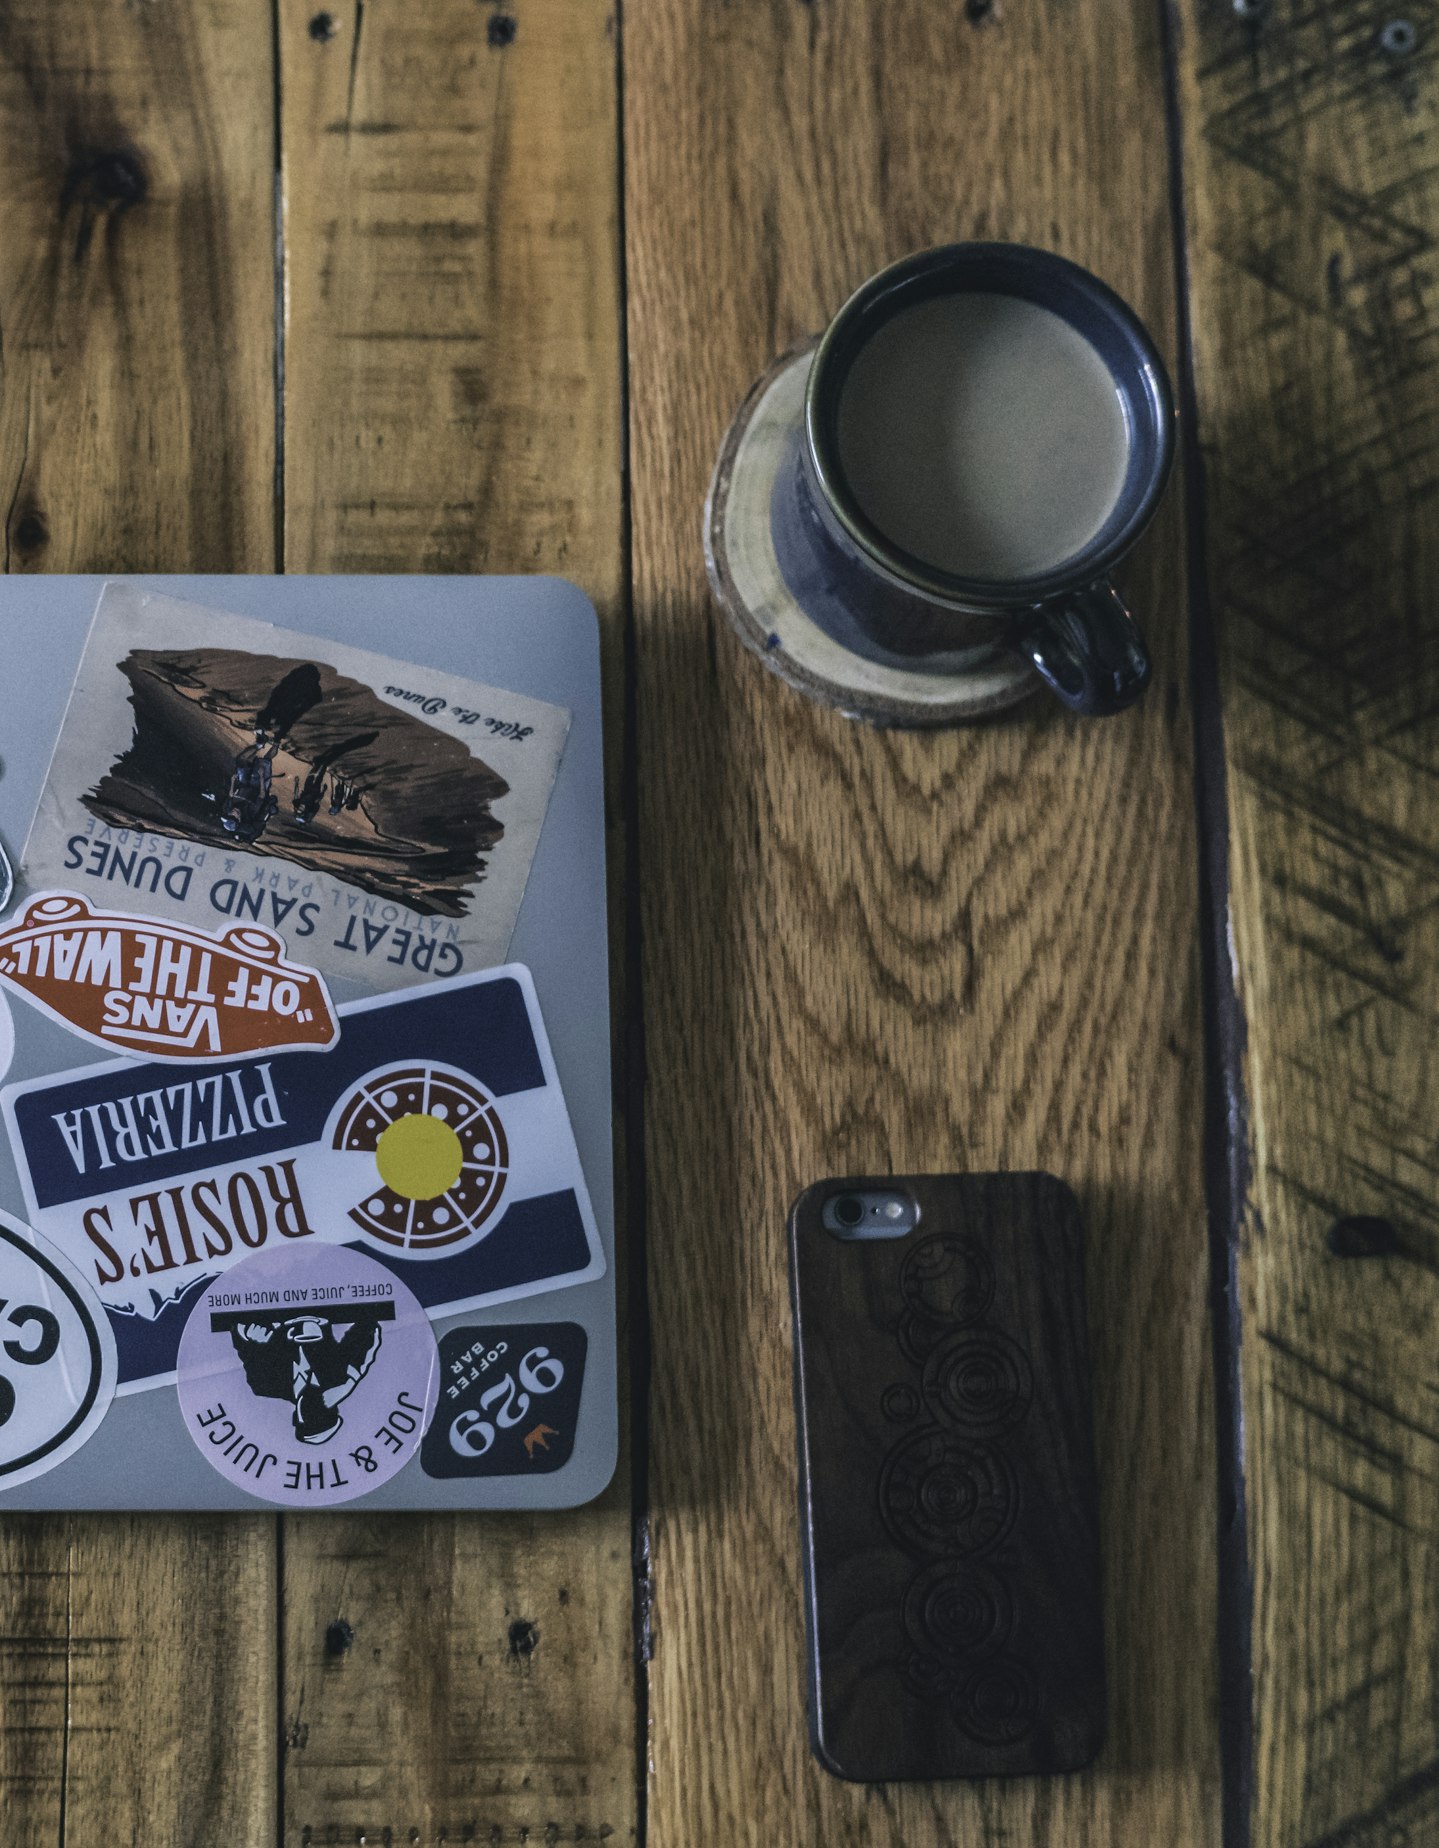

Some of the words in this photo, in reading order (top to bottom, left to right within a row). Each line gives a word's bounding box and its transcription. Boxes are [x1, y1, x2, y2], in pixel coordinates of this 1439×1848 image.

[383, 685, 447, 715] Dunes
[450, 706, 480, 725] the
[485, 718, 534, 742] Hike
[85, 818, 206, 867] PRESERVE
[223, 857, 236, 873] &
[63, 835, 194, 900] DUNES
[253, 867, 313, 898] PARK
[209, 878, 320, 937] SAND
[331, 890, 459, 941] NATIONAL
[129, 934, 215, 1001] THE
[333, 914, 464, 978] GREAT
[224, 967, 313, 1023] "OFF
[101, 990, 221, 1052] VANS
[51, 1062, 287, 1174] PIZZERIA
[83, 1159, 315, 1286] ROSIE'S
[207, 1294, 241, 1307] MORE
[245, 1291, 280, 1305] MUCH
[283, 1288, 308, 1302] AND
[311, 1286, 345, 1300] JUICE
[347, 1282, 393, 1296] COFFEE,
[446, 1341, 508, 1399] COFFEE
[450, 1341, 485, 1374] BAR
[374, 1391, 423, 1454] JOE
[449, 1346, 564, 1457] 929
[195, 1402, 277, 1479] JUICE
[348, 1445, 378, 1473] &
[283, 1459, 348, 1491] THE
